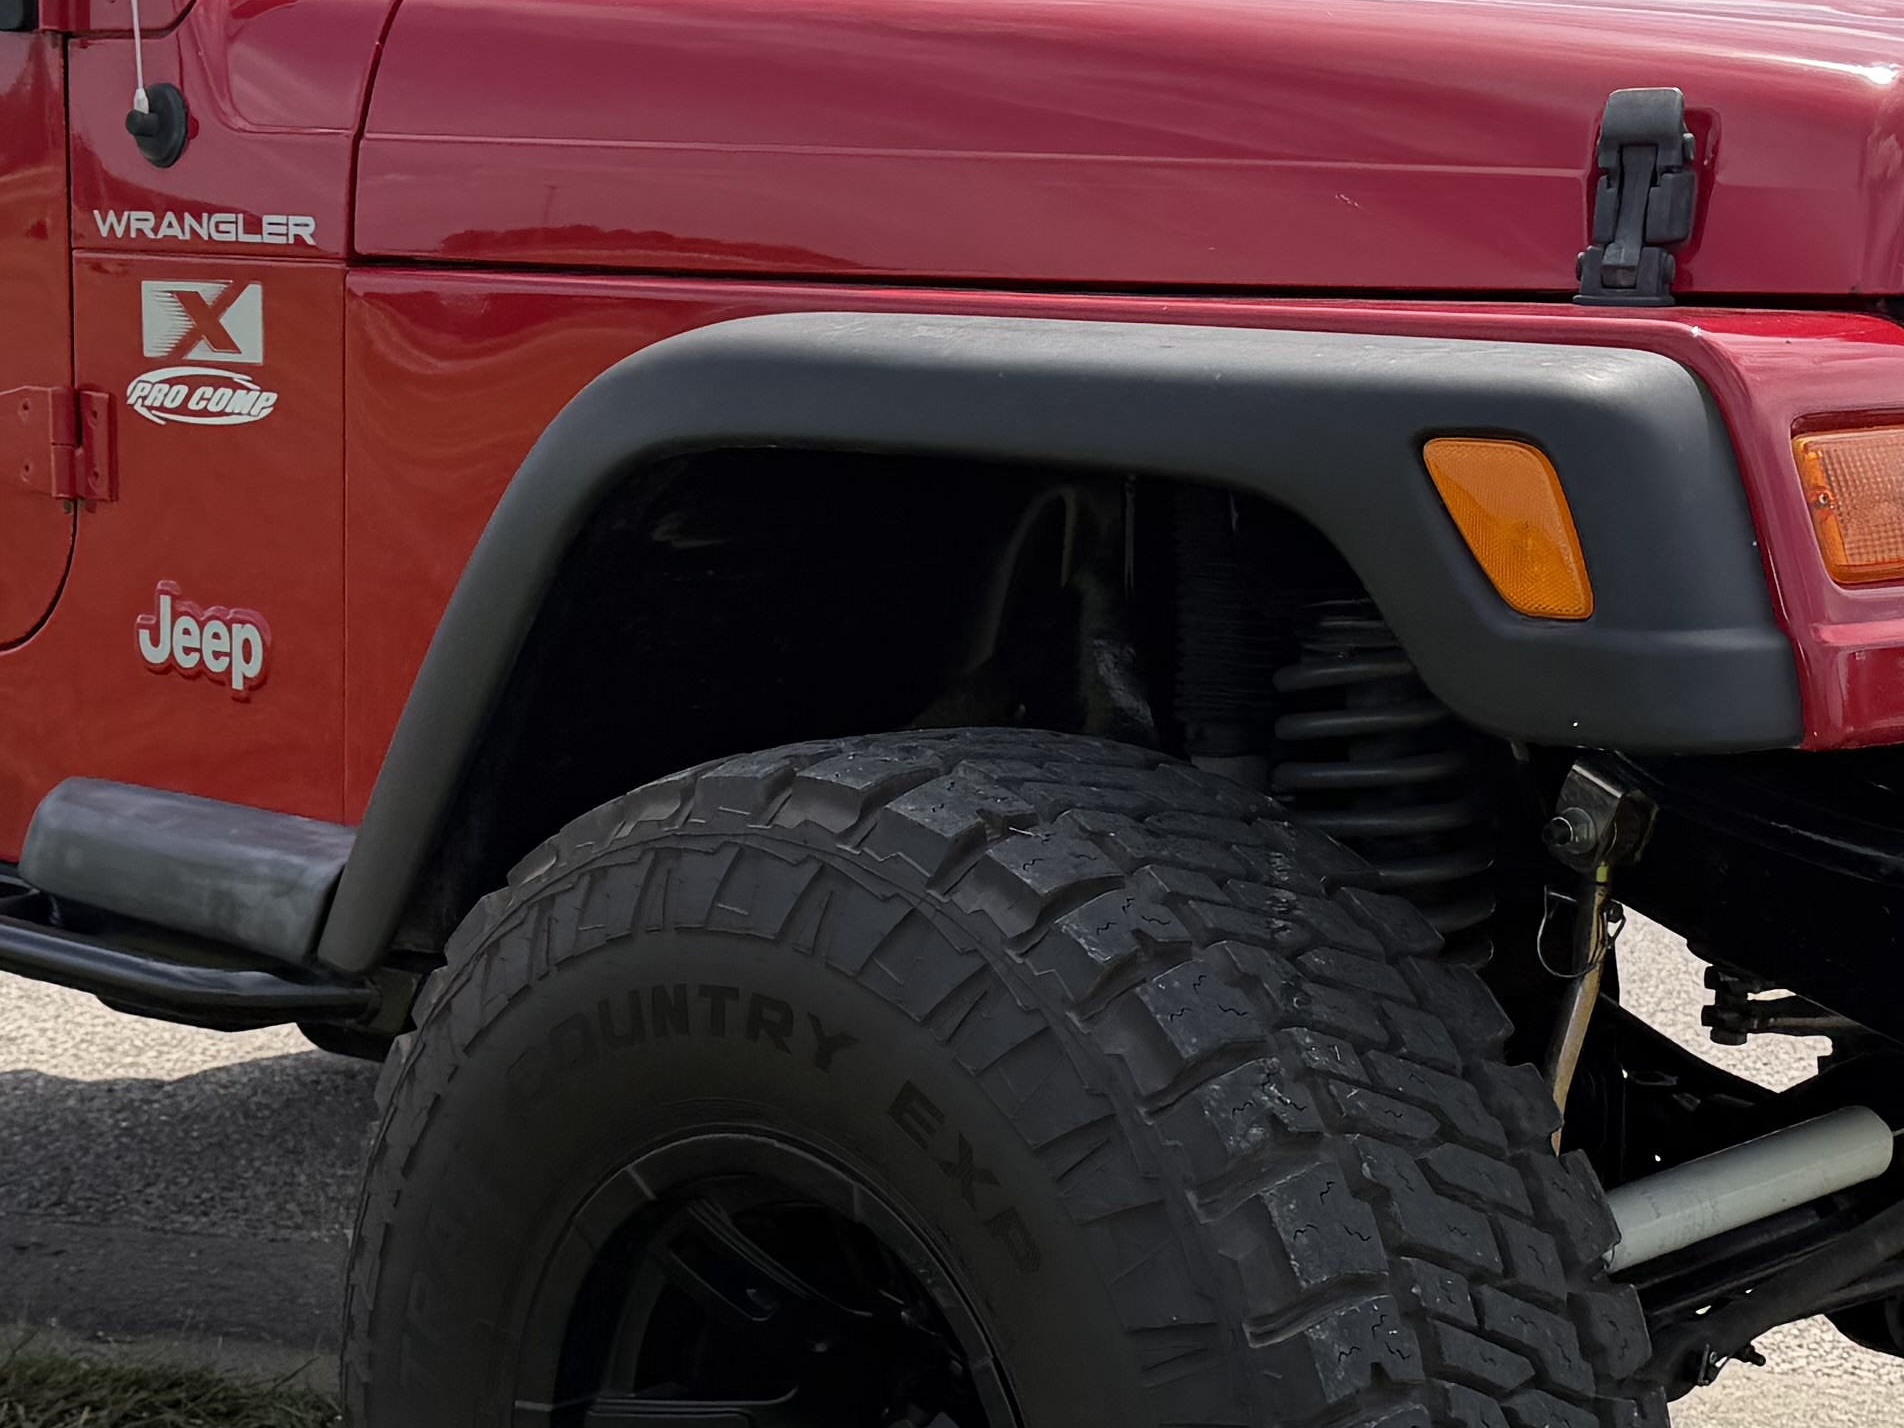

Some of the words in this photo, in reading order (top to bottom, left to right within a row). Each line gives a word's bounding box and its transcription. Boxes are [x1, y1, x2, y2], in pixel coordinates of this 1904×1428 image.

[93, 210, 316, 245] WRANGLER
[156, 279, 254, 364] X
[129, 379, 183, 408] PRO
[188, 386, 278, 416] COMP
[138, 595, 263, 690] Jeep
[506, 982, 861, 1107] COUNTRY
[888, 1079, 1043, 1275] EXP
